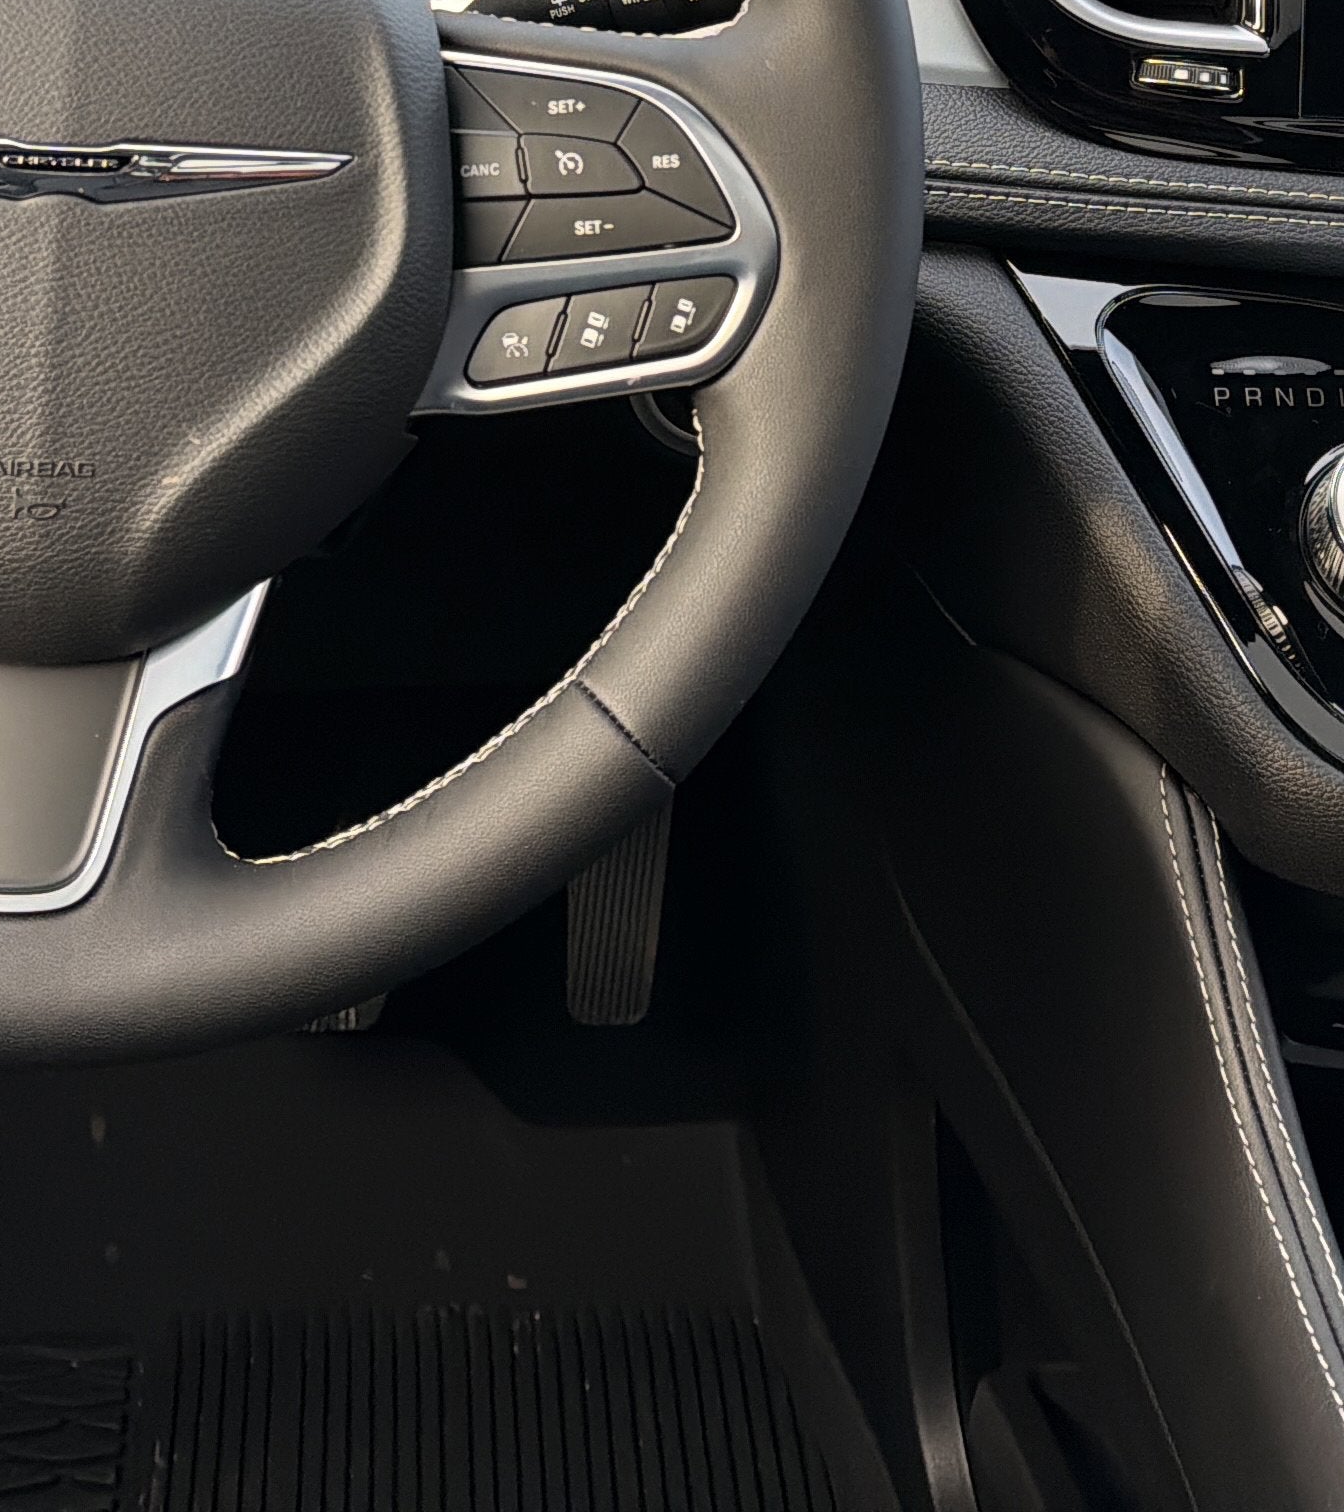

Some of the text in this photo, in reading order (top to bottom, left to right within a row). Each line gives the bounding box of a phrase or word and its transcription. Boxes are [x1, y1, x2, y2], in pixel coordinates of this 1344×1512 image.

[549, 4, 576, 20] PUSH
[651, 154, 681, 169] RES
[459, 162, 501, 178] CANC
